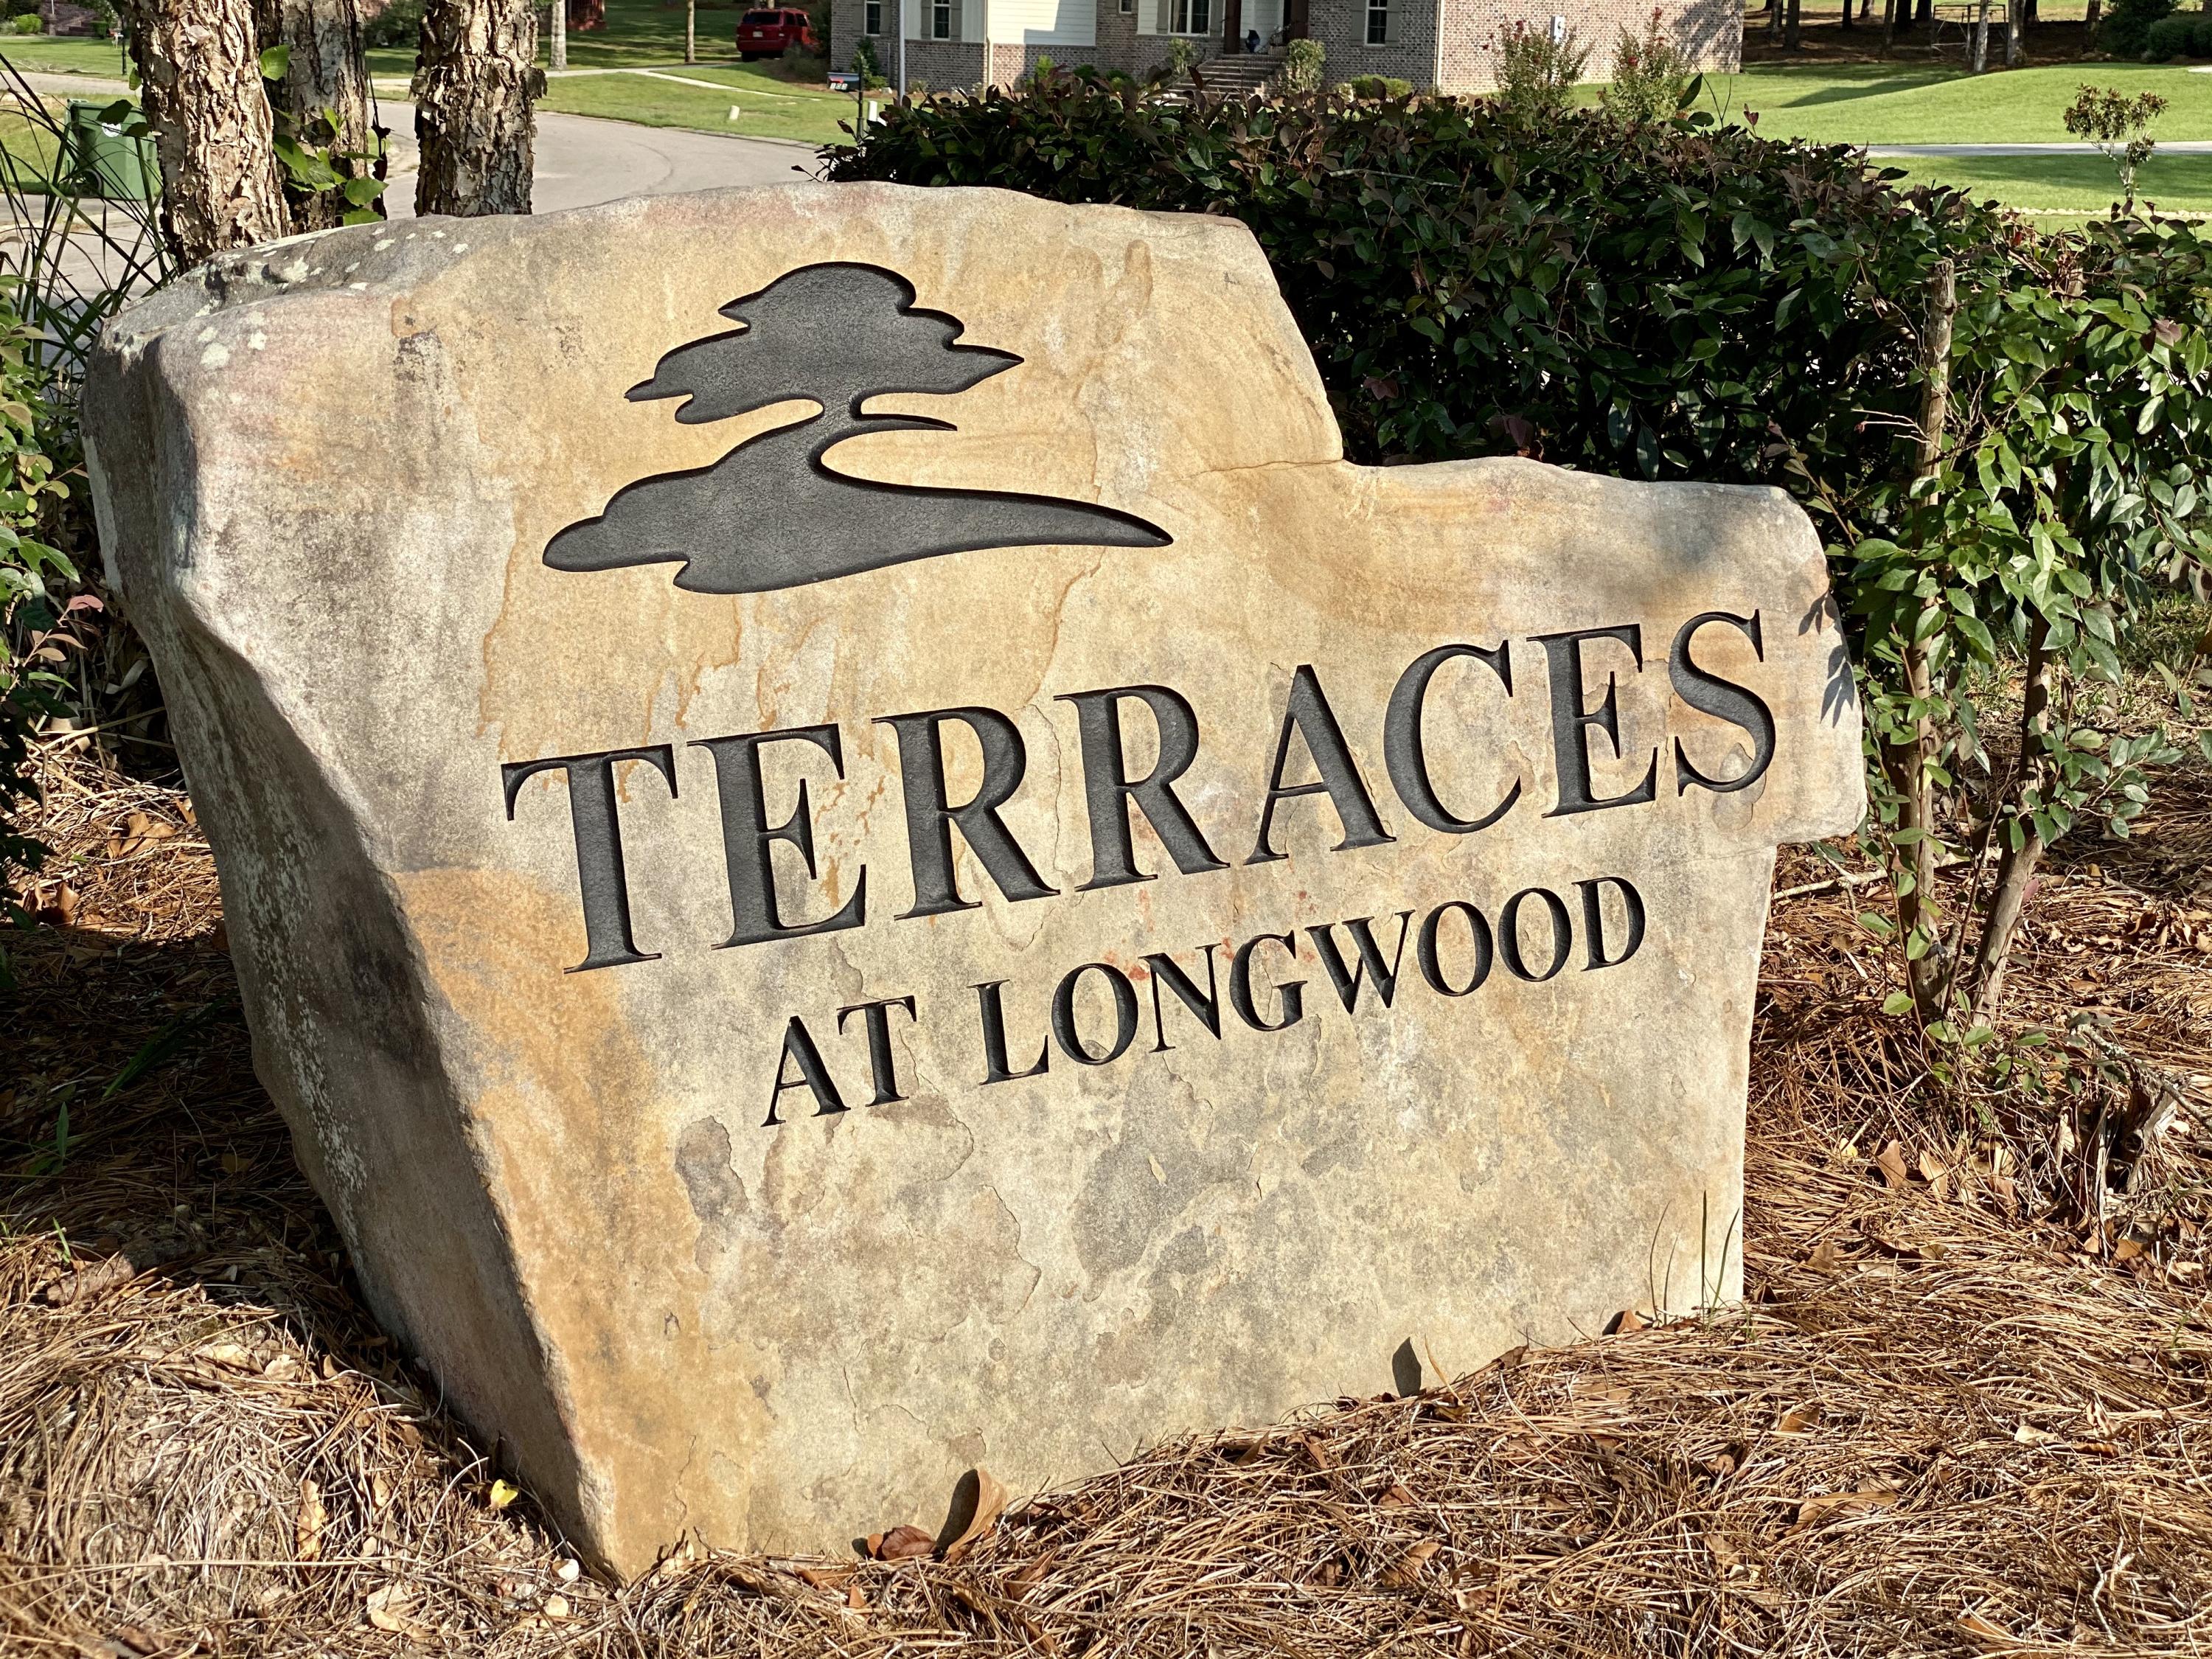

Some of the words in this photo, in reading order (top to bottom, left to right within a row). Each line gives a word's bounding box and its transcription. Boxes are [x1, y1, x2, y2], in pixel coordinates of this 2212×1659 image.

[501, 609, 1775, 974] TERRACES
[762, 995, 917, 1127] AT
[970, 877, 1645, 1085] LONGWOOD
